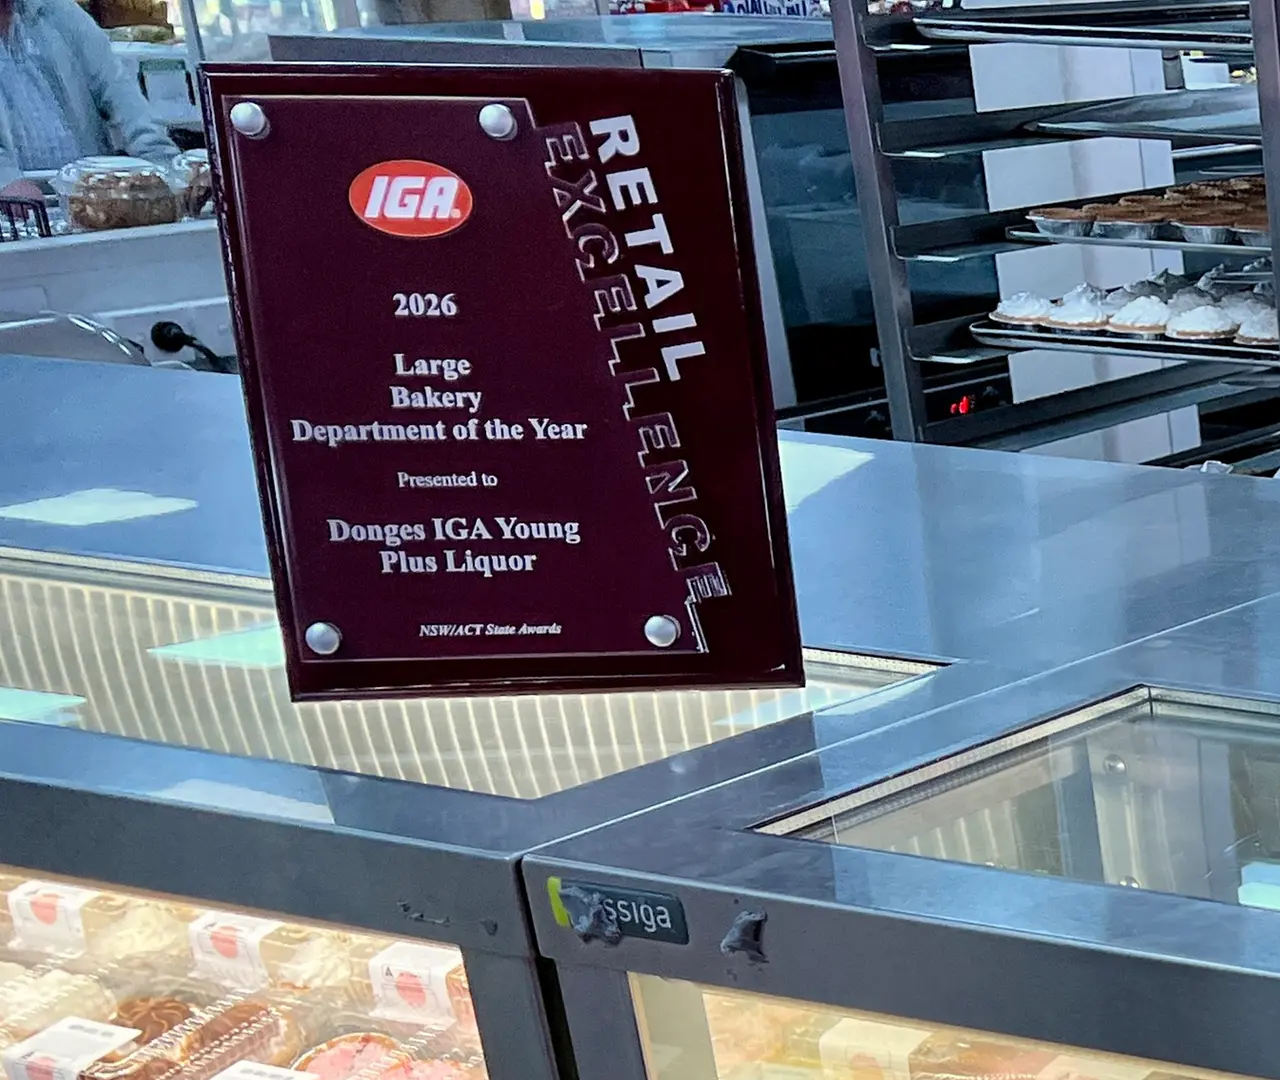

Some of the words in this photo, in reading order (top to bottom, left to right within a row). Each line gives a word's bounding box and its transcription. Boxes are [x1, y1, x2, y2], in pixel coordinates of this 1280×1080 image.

[364, 176, 460, 218] IGA
[588, 113, 706, 382] RETAIL
[392, 292, 458, 316] 2026
[394, 353, 472, 380] Large
[544, 121, 733, 599] EXCELLENCE
[390, 386, 482, 413] Bakery
[290, 419, 447, 448] Department
[452, 419, 479, 440] of
[485, 419, 524, 440] the
[528, 418, 588, 440] Year
[397, 471, 477, 487] Presented
[481, 473, 498, 487] to
[326, 519, 426, 547] Donges
[431, 517, 493, 540] IGA
[494, 517, 581, 544] Young
[379, 550, 437, 574] Plus
[443, 550, 537, 577] Liquor
[419, 623, 484, 637] NSW/ACT
[485, 623, 517, 636] State
[518, 623, 562, 635] Awards
[602, 898, 671, 932] ssiga
